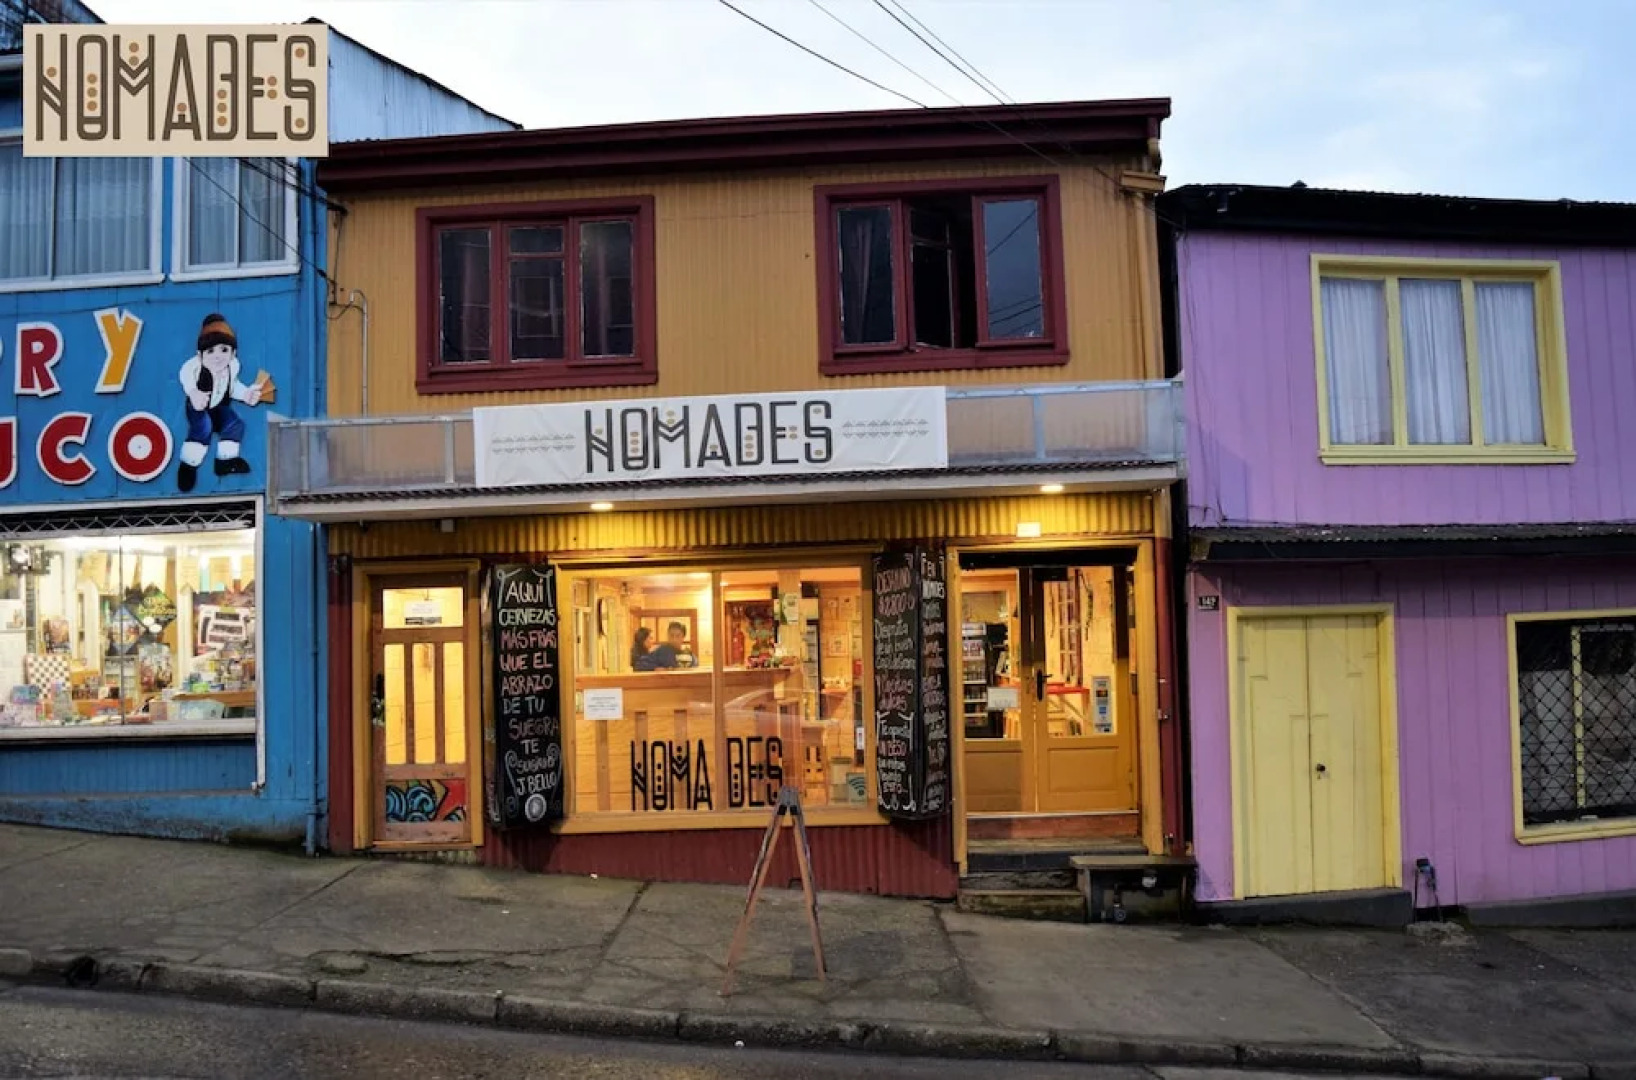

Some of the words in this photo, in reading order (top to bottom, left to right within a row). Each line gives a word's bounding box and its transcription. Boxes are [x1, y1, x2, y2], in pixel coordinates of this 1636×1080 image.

[0, 321, 64, 397] R
[93, 307, 143, 394] Y
[585, 400, 832, 473] NOMADES
[505, 577, 544, 603] AQUÍ
[499, 608, 556, 626] CERVEZAS
[501, 627, 528, 650] MÁS
[500, 653, 528, 672] QUE
[533, 651, 553, 669] EL
[501, 673, 554, 697] ABRAZO
[503, 696, 521, 714] DE
[525, 695, 545, 715] TU
[509, 716, 558, 739] SUEGRA
[521, 737, 539, 755] TE
[631, 738, 713, 813] NOMA
